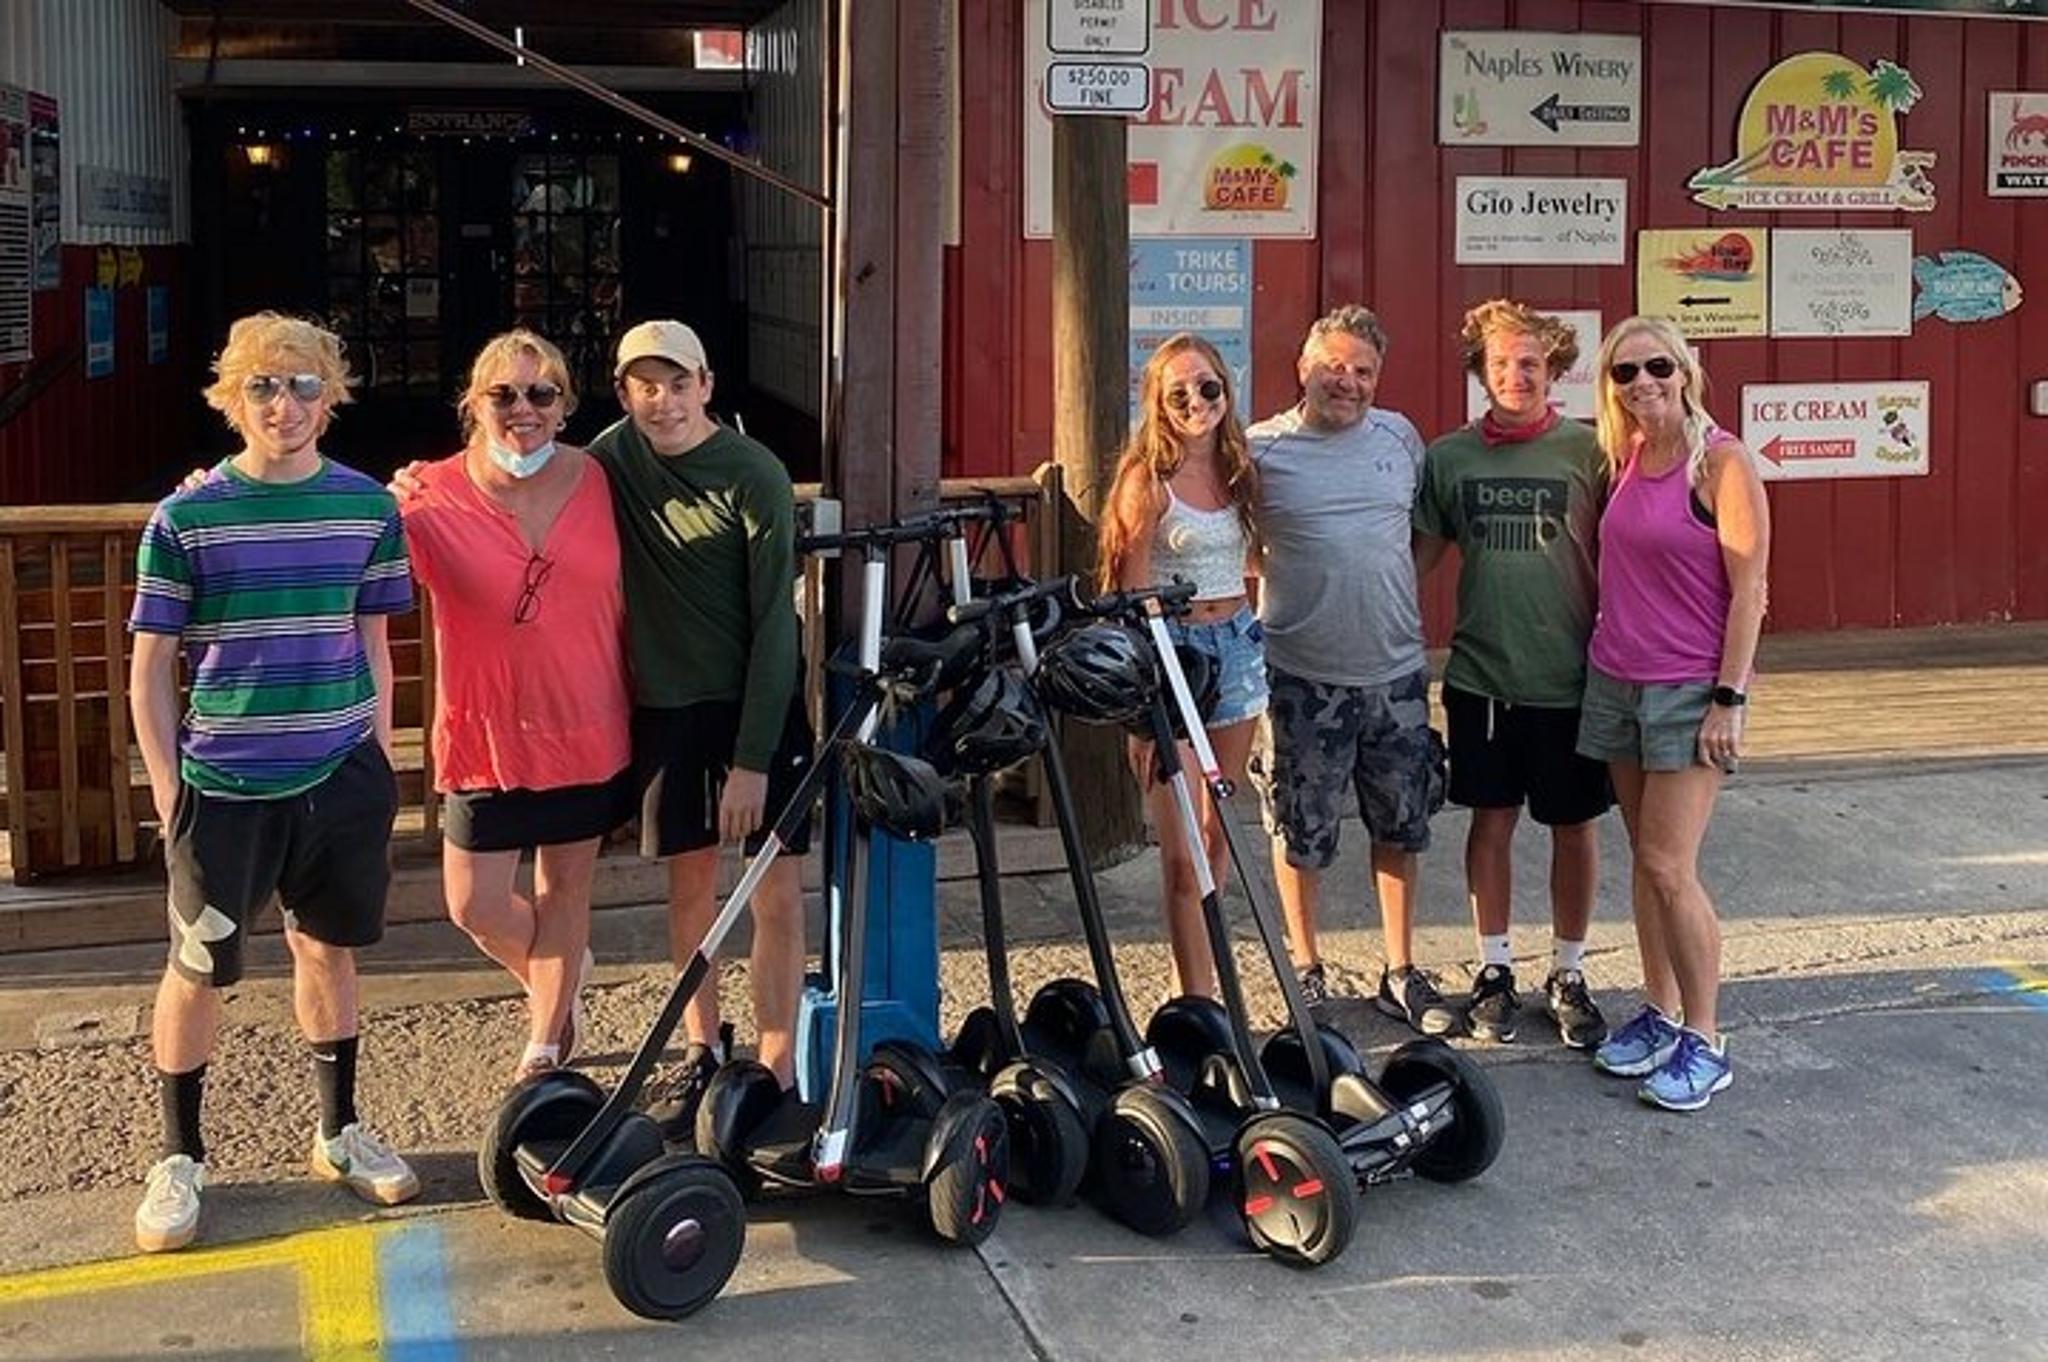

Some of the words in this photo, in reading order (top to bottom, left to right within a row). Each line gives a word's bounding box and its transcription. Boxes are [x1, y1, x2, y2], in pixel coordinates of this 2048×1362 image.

[1080, 16, 1117, 28] PERMIT
[1153, 0, 1278, 32] ICE
[1084, 35, 1112, 47] ONLY
[1068, 68, 1130, 86] $250.00
[1080, 87, 1113, 105] FINE
[1766, 104, 1879, 136] M&M's
[1770, 139, 1873, 169] CAFE
[1216, 187, 1275, 203] CAFE
[1745, 190, 1770, 205] ICE
[1774, 190, 1829, 205] CREAM
[1831, 191, 1845, 205] &
[1848, 191, 1894, 205] GRILL
[1467, 189, 1514, 215] Gio
[1521, 191, 1619, 222] Jewelry
[1556, 230, 1572, 243] of
[1574, 229, 1617, 246] Naples
[1176, 250, 1237, 270] TRIKE
[1166, 272, 1247, 294] TOURS!
[1752, 401, 1787, 422] ICE
[1792, 400, 1867, 422] CREAM
[1779, 443, 1806, 456] FREE
[1808, 442, 1851, 456] SAMPLE
[1478, 482, 1552, 508] beer
